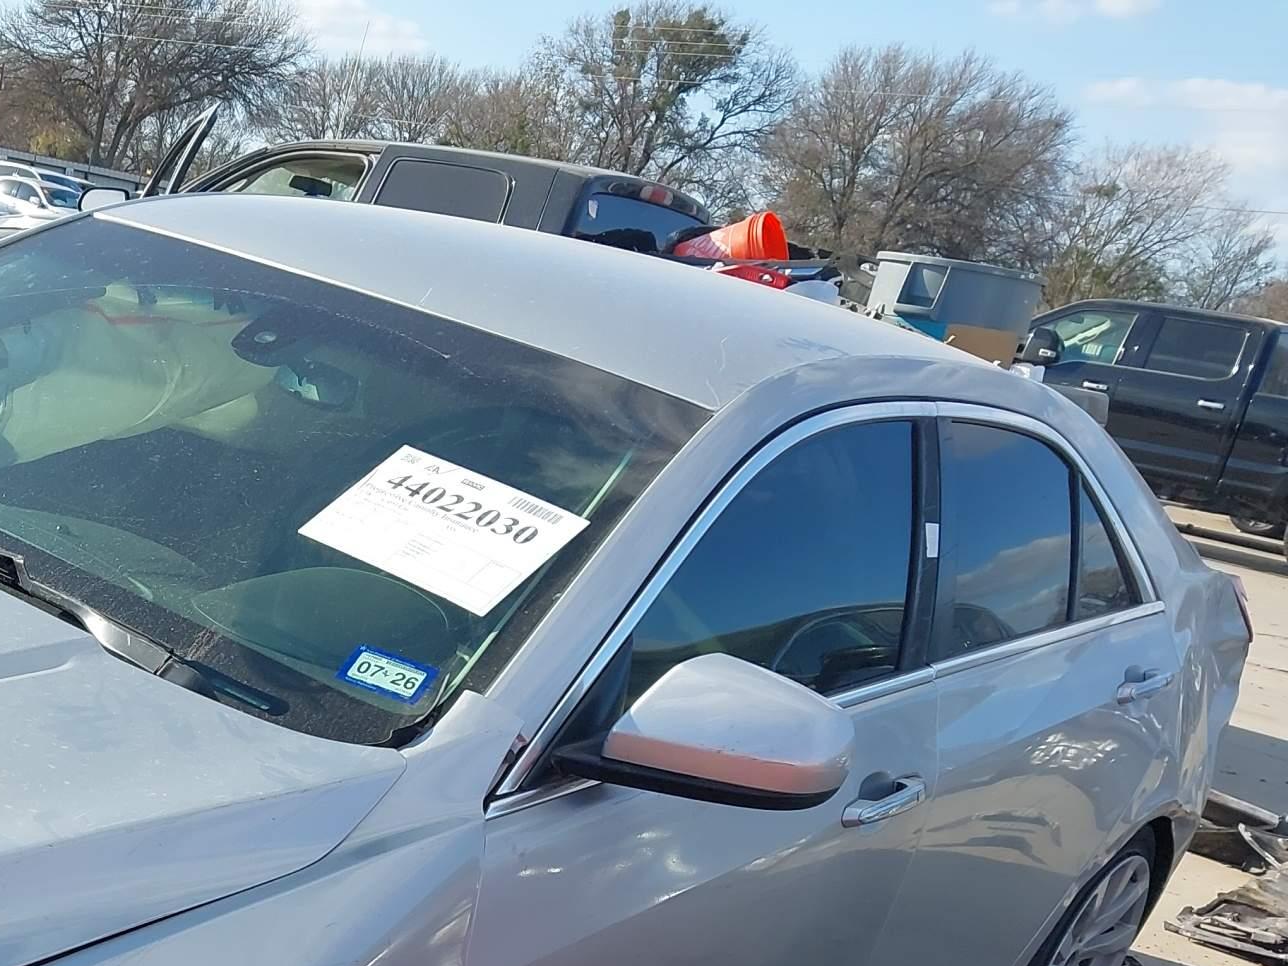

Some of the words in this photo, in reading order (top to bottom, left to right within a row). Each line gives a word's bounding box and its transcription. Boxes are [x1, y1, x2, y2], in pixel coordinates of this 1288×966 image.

[385, 474, 539, 545] 44022030
[357, 661, 385, 677] 07
[390, 672, 419, 690] 26
